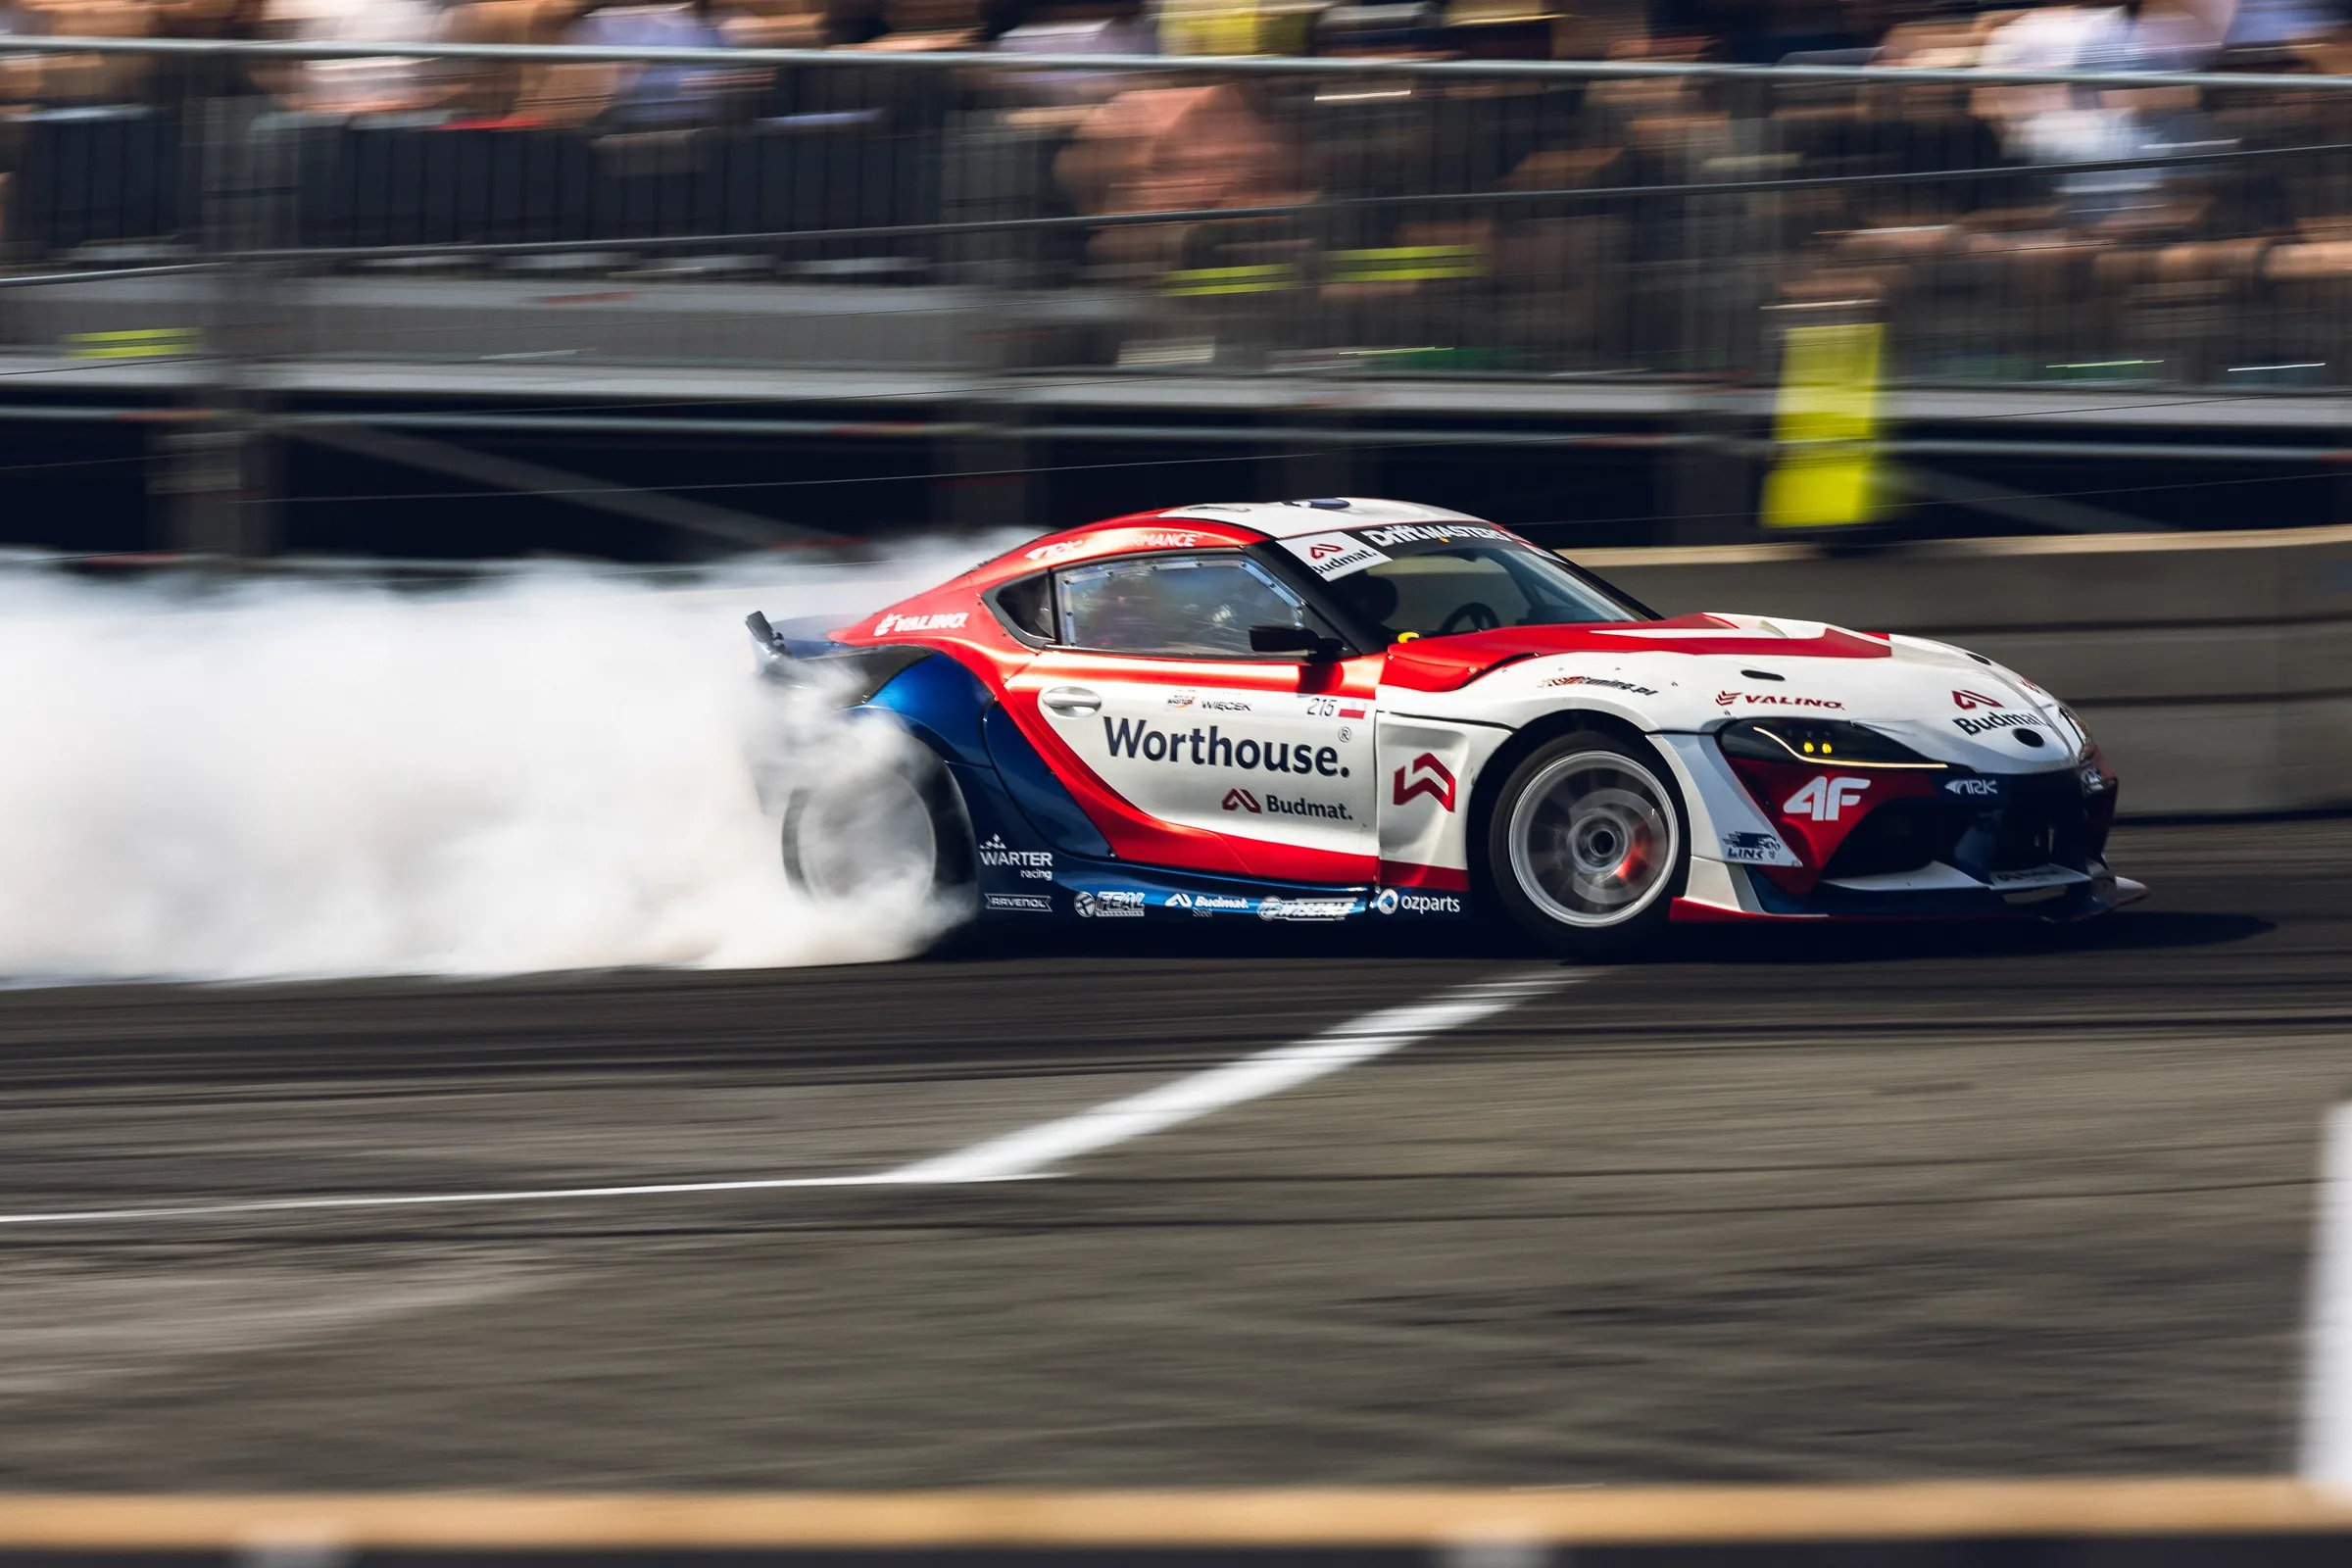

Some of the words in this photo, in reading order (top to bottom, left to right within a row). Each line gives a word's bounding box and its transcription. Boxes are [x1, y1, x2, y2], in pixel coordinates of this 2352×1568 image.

[1306, 697, 1337, 716] 215
[1745, 695, 1845, 710] VALINO
[1103, 715, 1350, 778] Worthouse.
[1265, 794, 1353, 820] Budmat.
[1784, 776, 1871, 821] 4F
[980, 851, 1054, 866] WARTER
[1020, 868, 1053, 881] racing
[1401, 896, 1461, 914] ozparts
